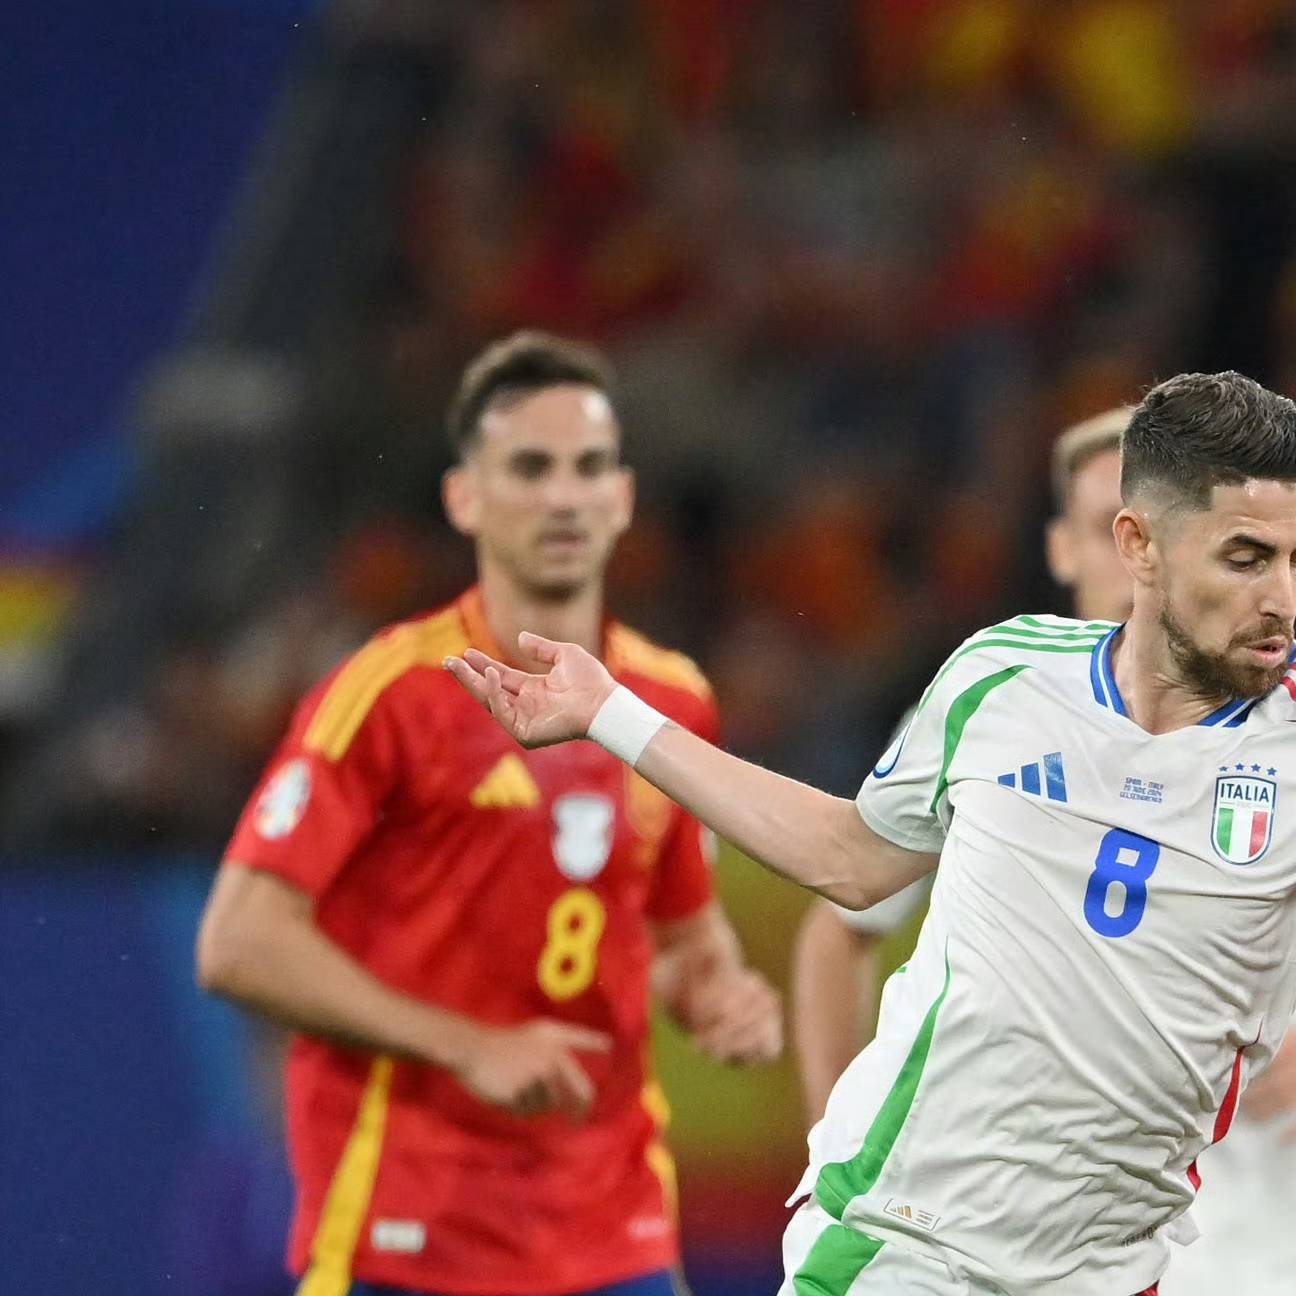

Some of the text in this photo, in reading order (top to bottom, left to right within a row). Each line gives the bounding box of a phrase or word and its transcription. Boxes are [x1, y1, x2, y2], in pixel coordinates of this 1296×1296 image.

[1220, 783, 1269, 803] ITALIA
[1083, 826, 1161, 938] 8
[537, 886, 607, 1003] 8
